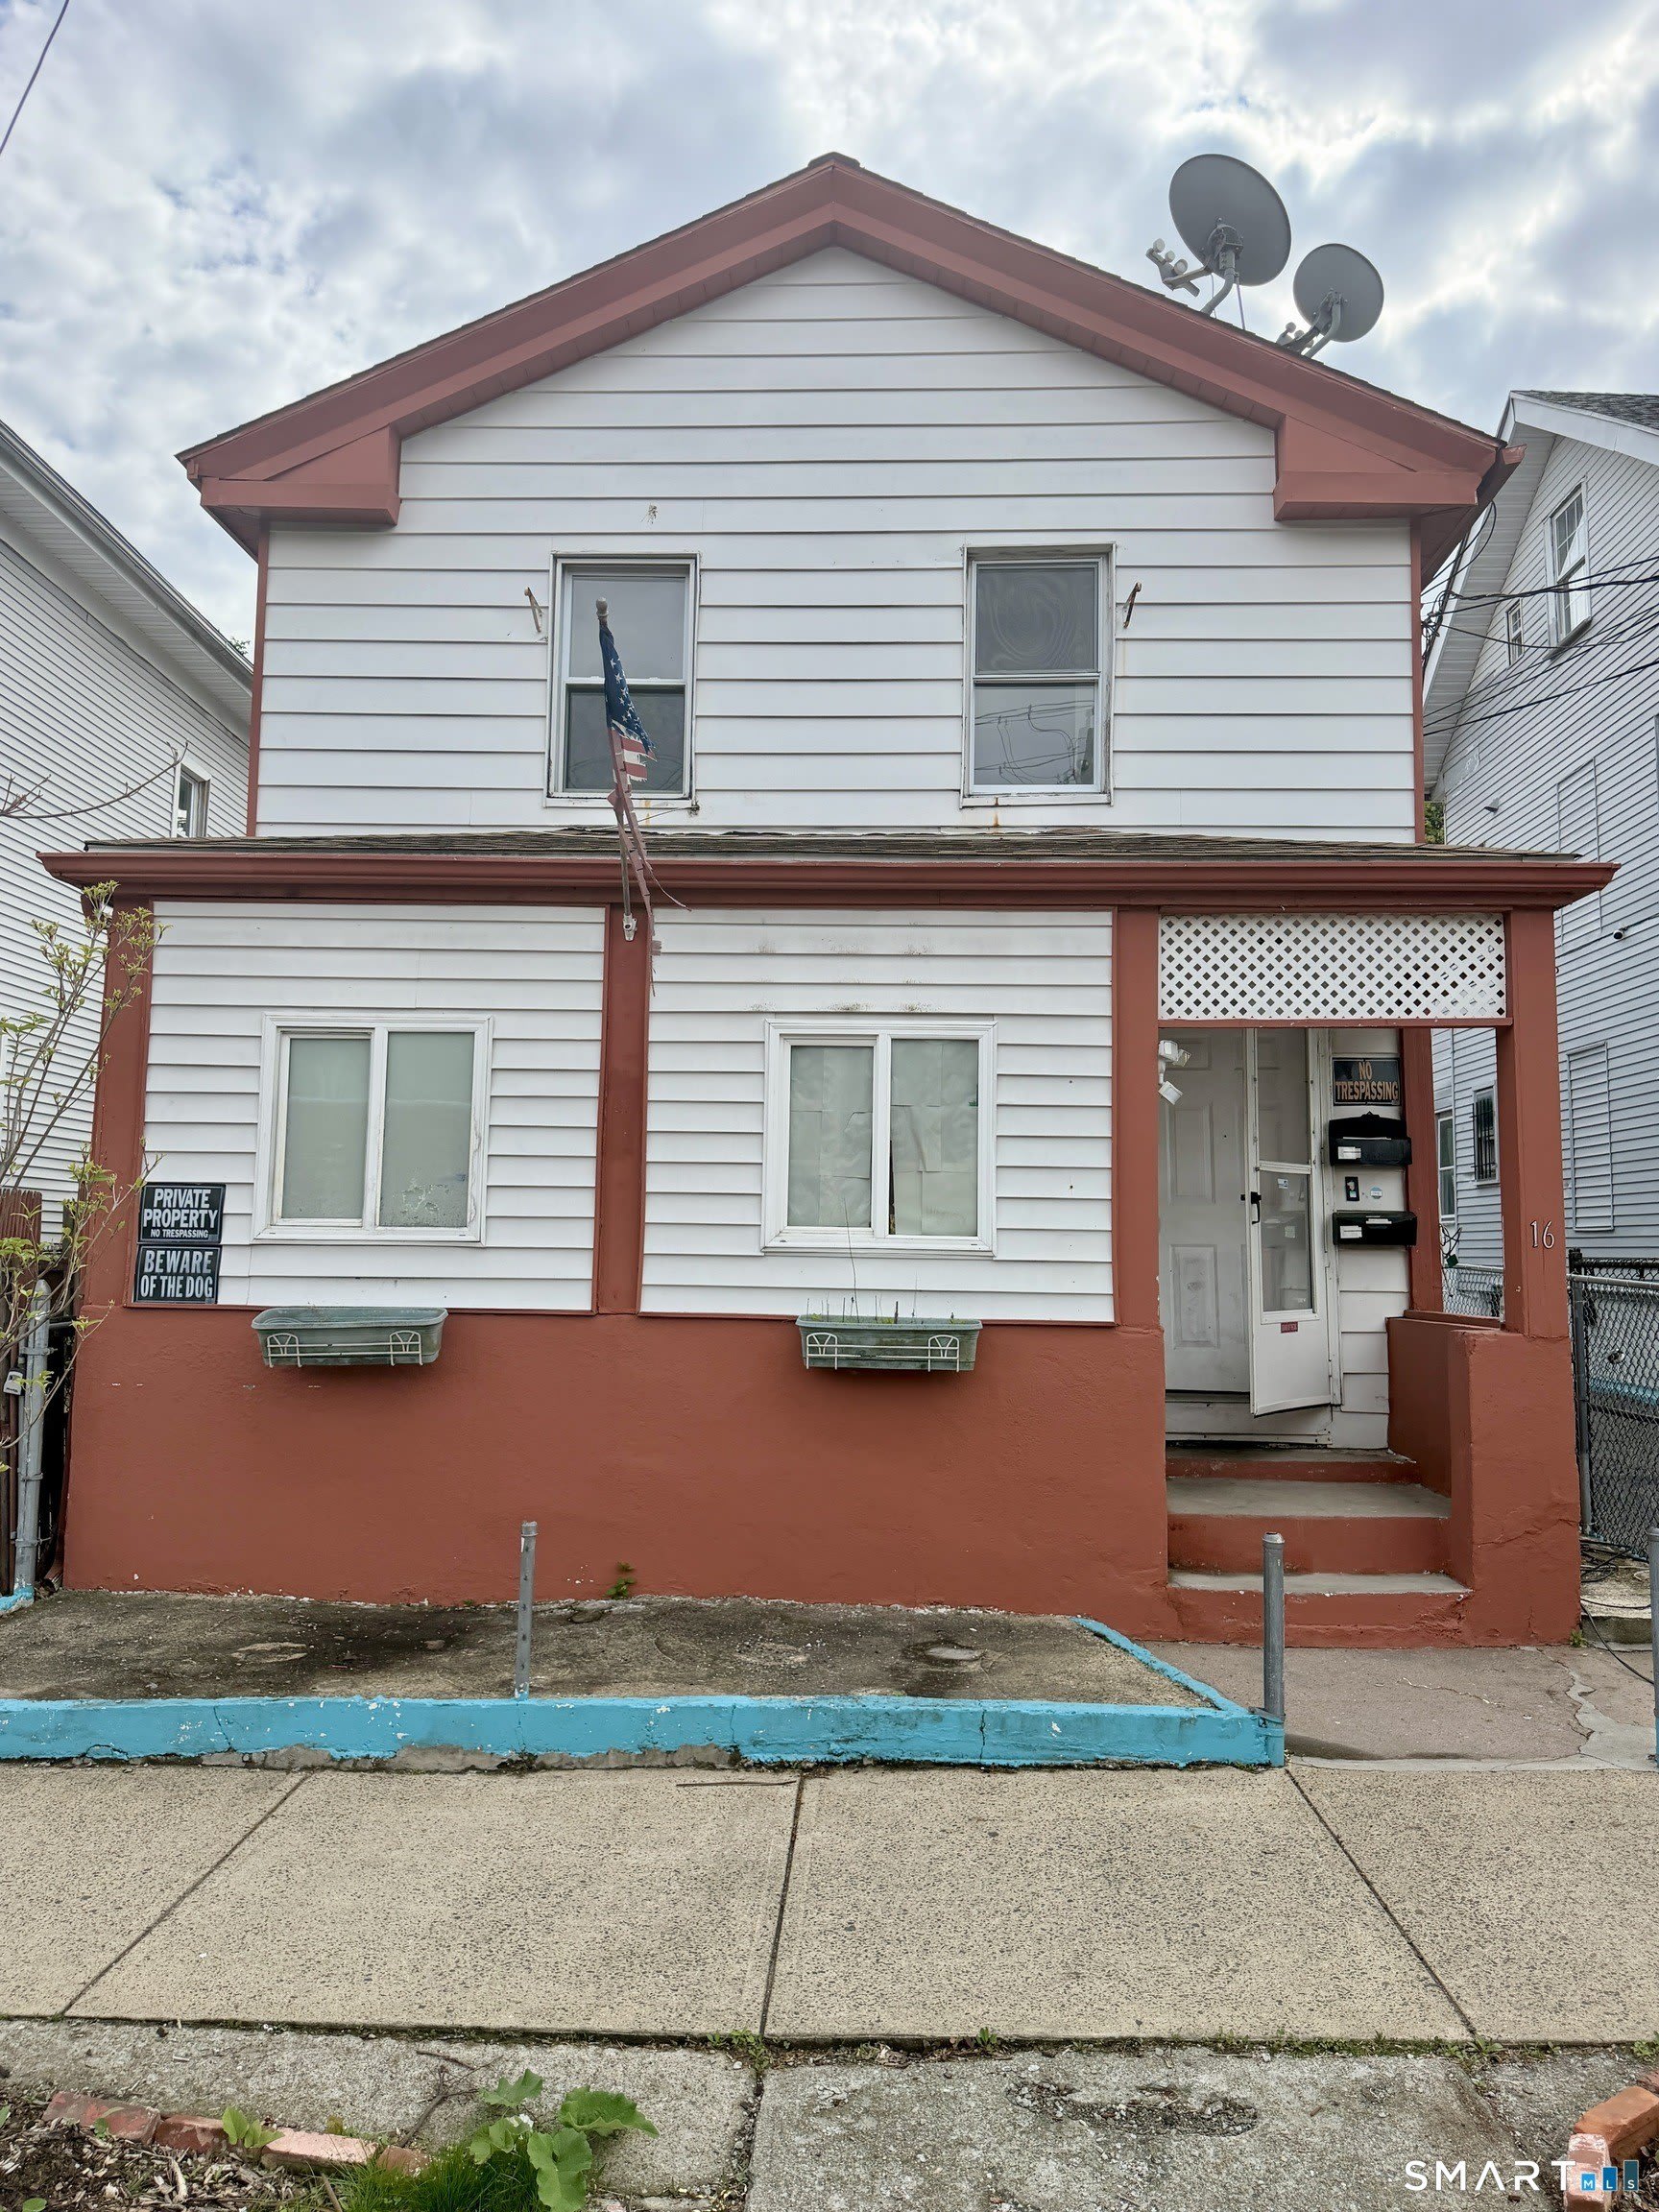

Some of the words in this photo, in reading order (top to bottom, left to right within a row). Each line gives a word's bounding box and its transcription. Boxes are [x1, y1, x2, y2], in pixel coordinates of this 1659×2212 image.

[1358, 1061, 1373, 1081] NO
[1335, 1081, 1399, 1101] TRESPASSING
[154, 1189, 211, 1208] PRIVATE
[143, 1209, 218, 1228] PROPERTY
[151, 1229, 159, 1238] NO
[162, 1229, 209, 1238] TRESPASSING
[1530, 1219, 1555, 1249] 16
[145, 1250, 213, 1273] BEWARE
[141, 1275, 156, 1296] OF
[159, 1275, 183, 1297] THE
[185, 1275, 213, 1298] DOG
